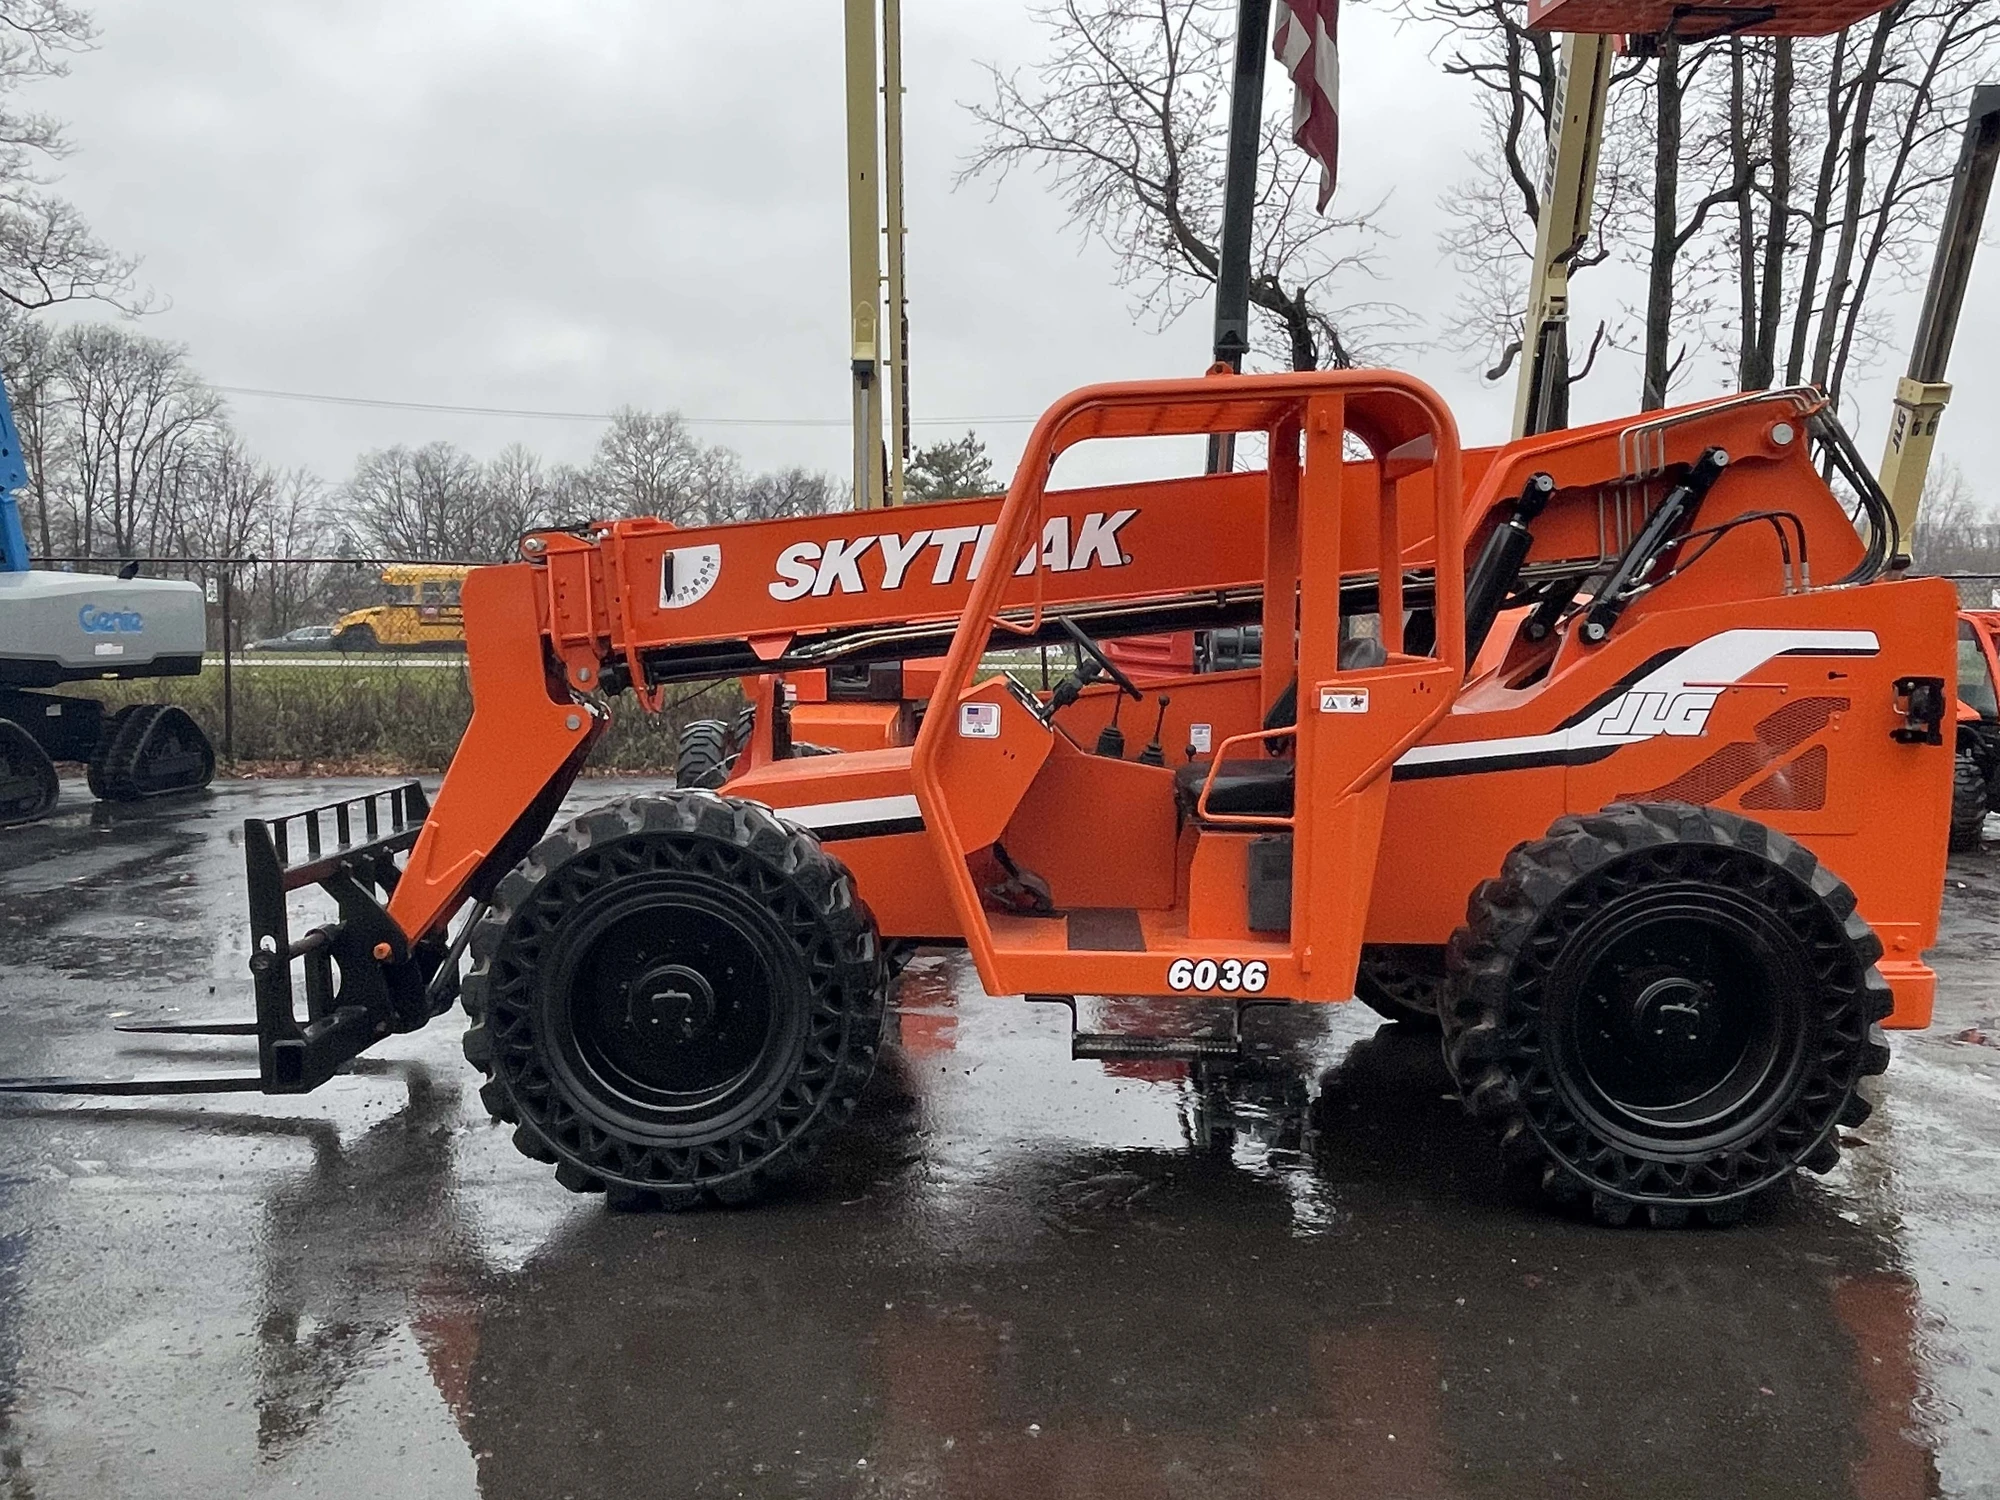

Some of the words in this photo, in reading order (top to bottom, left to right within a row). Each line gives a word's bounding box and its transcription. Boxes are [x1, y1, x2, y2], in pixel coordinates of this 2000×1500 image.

[1552, 58, 1567, 134] LIFT
[1892, 409, 1906, 454] JLG
[1597, 691, 1719, 736] JLG
[1167, 958, 1269, 993] 6036
